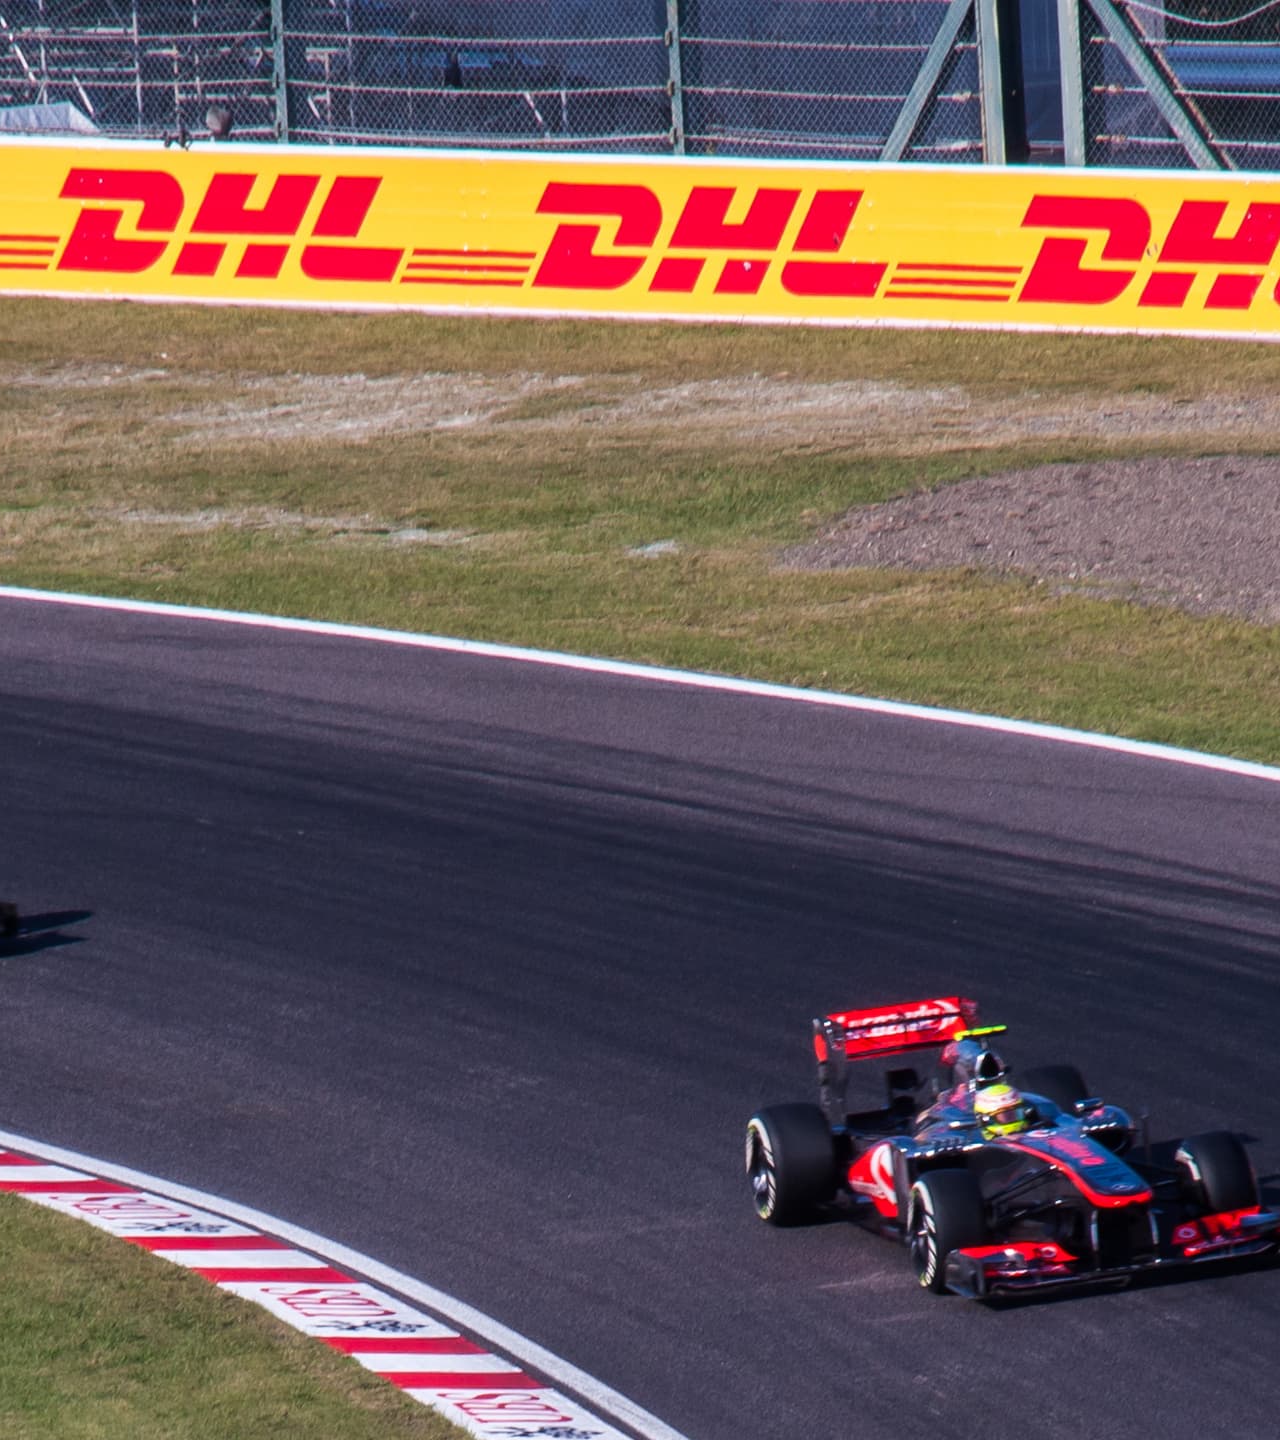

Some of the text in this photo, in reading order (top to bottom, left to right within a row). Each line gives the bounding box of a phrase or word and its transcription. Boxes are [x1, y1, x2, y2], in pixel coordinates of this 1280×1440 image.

[57, 167, 405, 282] DHL
[532, 181, 888, 299] DHL
[260, 1288, 396, 1317] UBS
[437, 1393, 573, 1423] UBS
